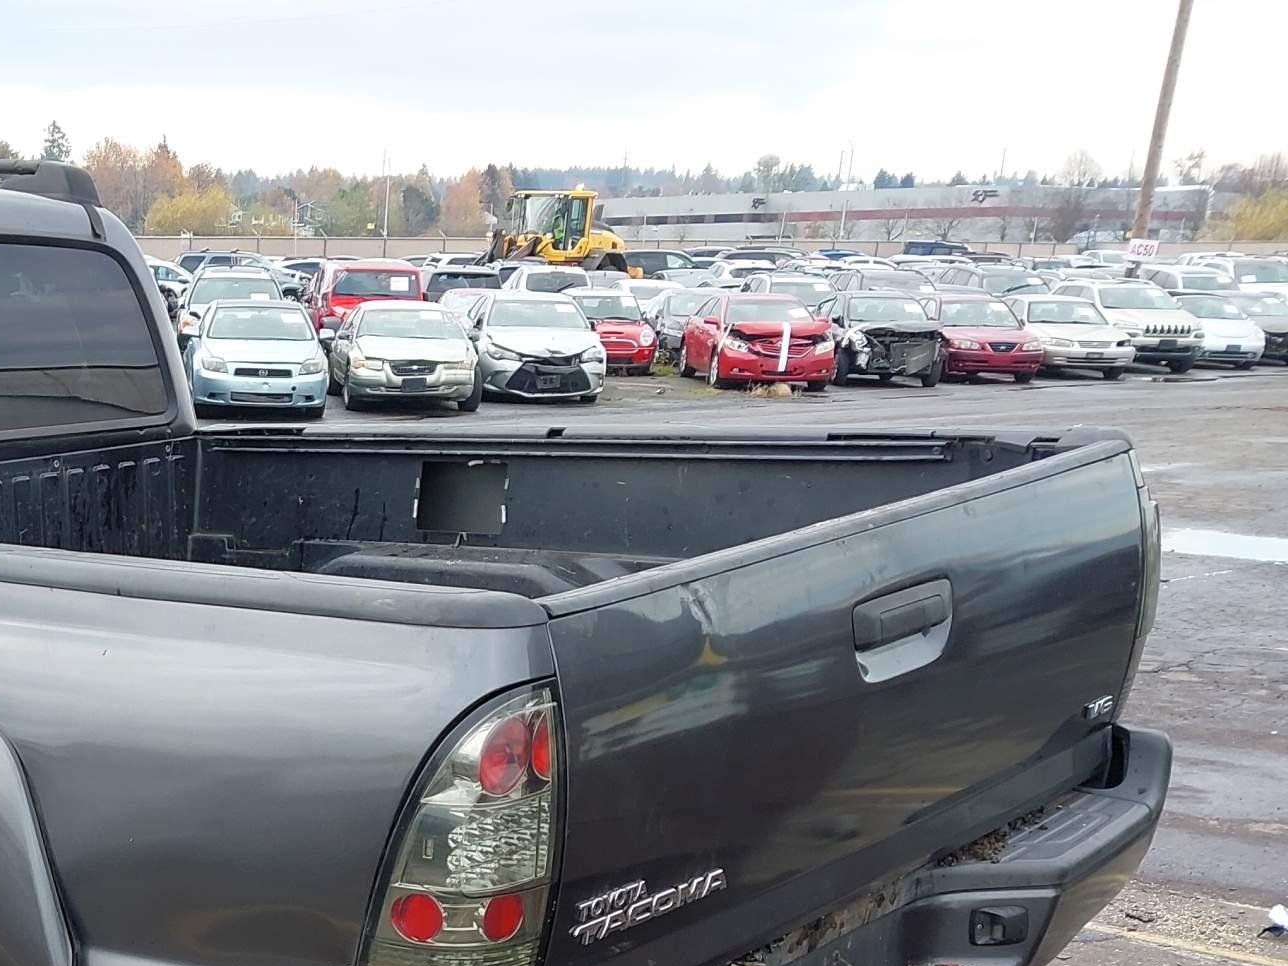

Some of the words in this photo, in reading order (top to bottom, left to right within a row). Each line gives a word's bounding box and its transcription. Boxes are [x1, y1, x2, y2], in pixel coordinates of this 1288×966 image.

[1130, 243, 1155, 257] AC50
[569, 868, 728, 946] TACOMA
[576, 880, 648, 922] TOYOTA
